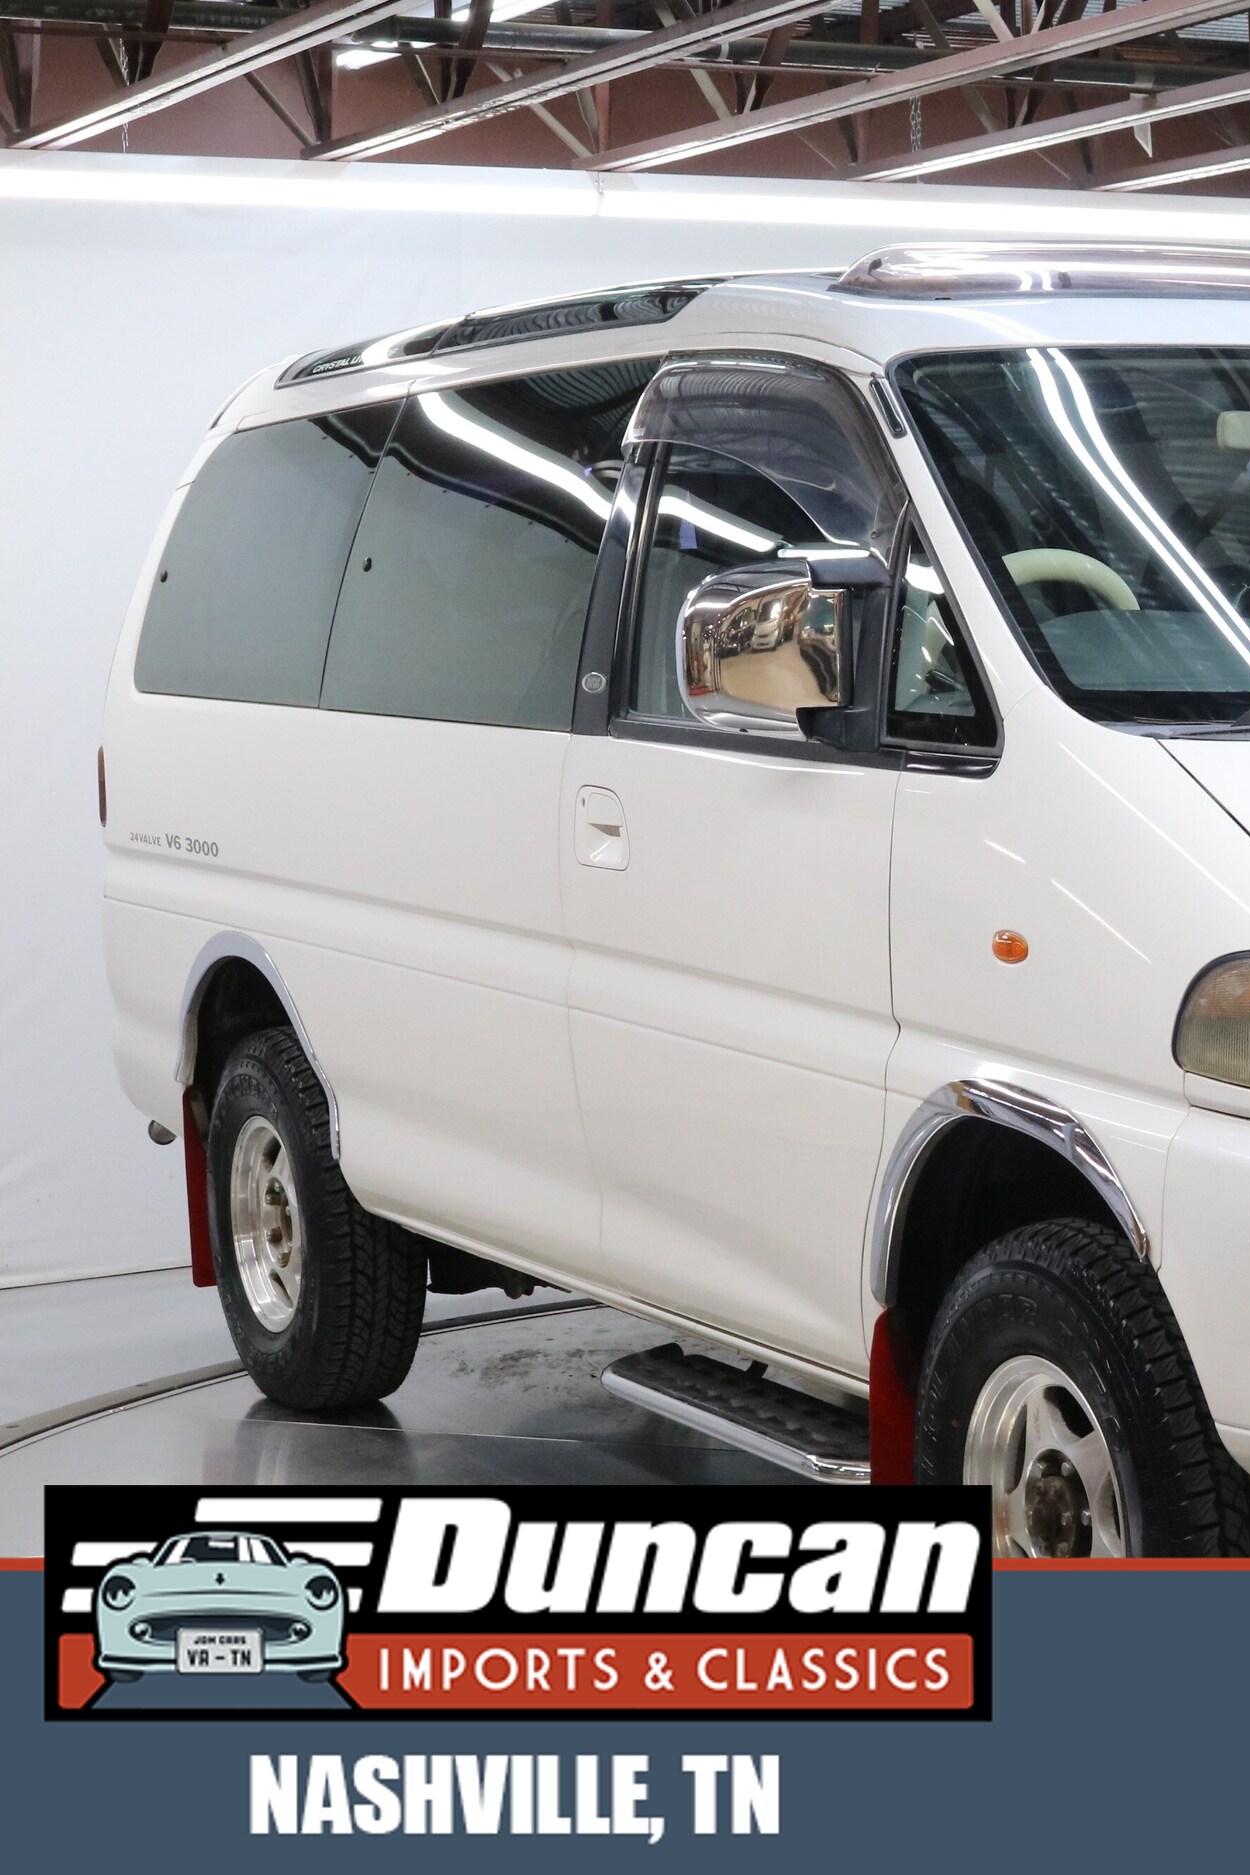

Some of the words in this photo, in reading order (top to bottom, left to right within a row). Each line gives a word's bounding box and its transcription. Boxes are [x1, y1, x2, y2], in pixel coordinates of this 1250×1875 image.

[312, 357, 350, 373] CRYSTAL
[130, 831, 162, 847] 24VALVE
[165, 833, 182, 850] V6
[185, 837, 219, 857] 3000
